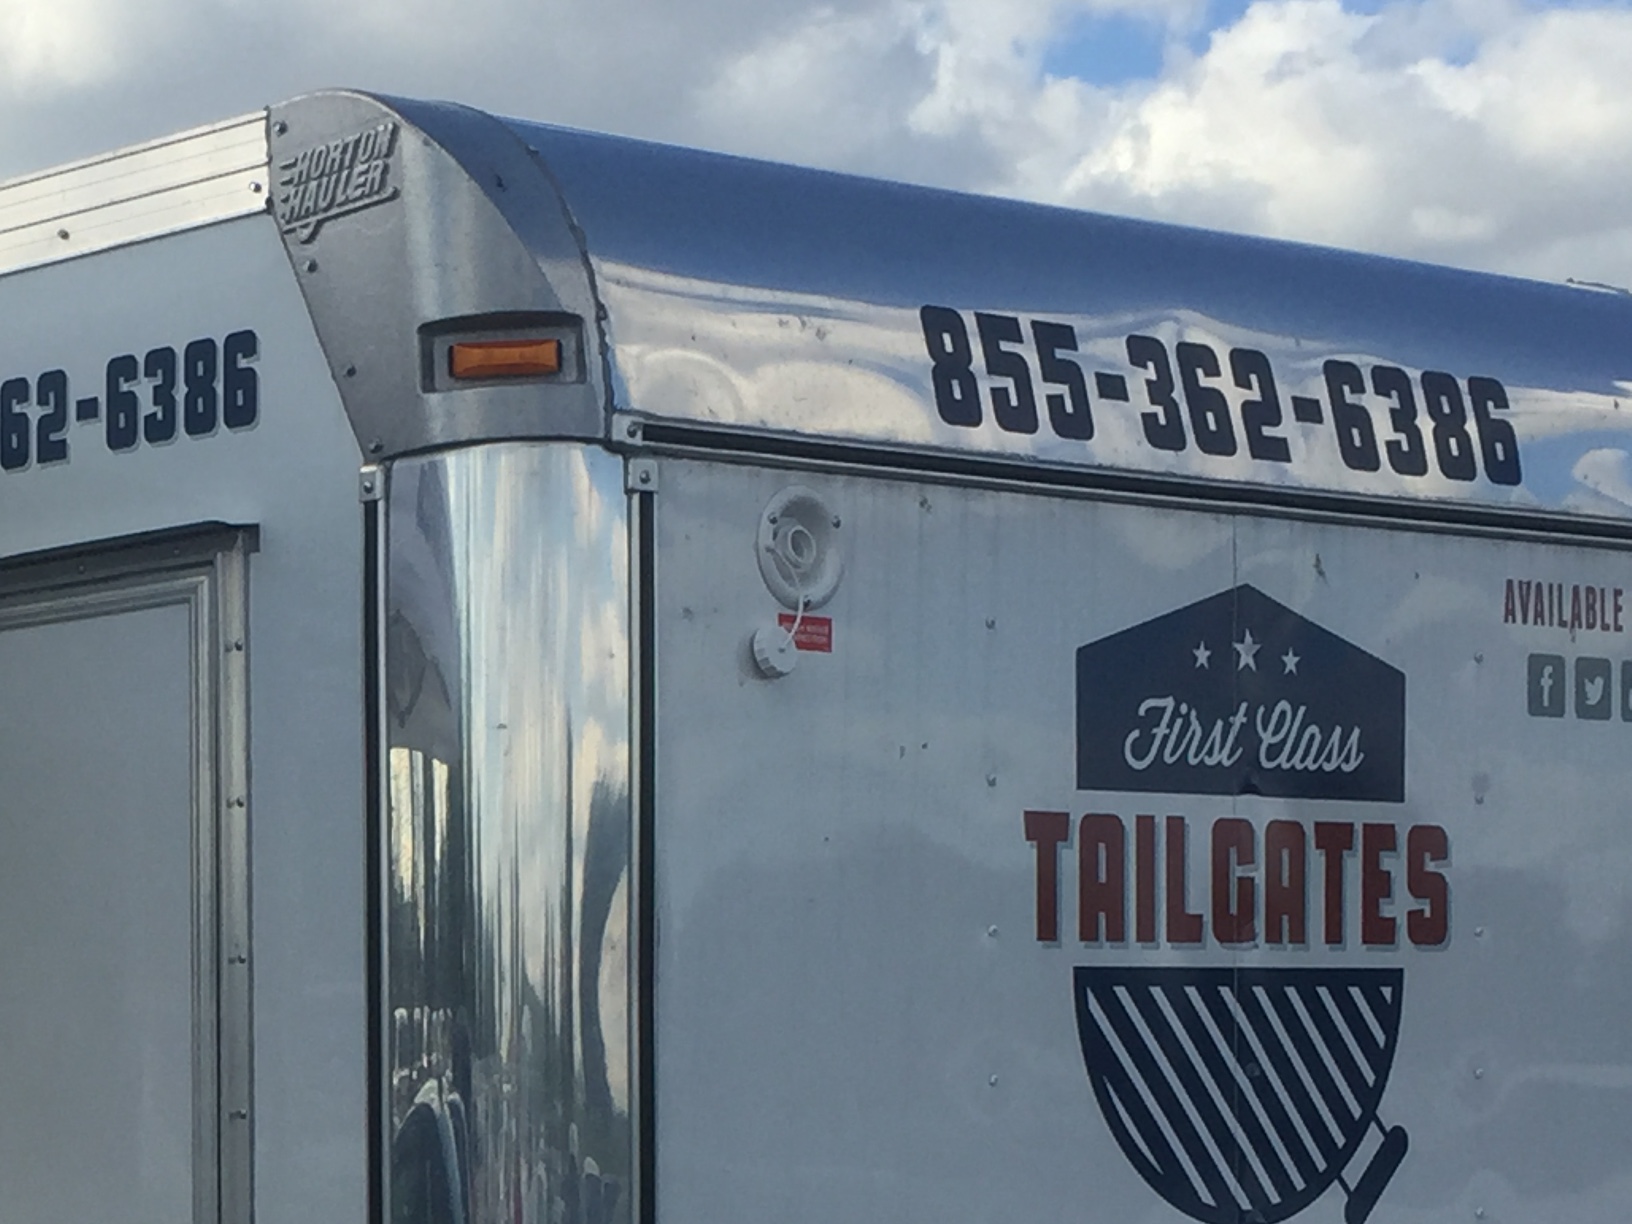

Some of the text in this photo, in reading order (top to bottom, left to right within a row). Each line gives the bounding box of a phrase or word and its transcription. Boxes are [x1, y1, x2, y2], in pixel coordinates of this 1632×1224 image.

[289, 122, 400, 187] HORTON
[284, 160, 390, 225] HAULER
[919, 304, 1522, 486] 855-362-6386
[1503, 578, 1624, 632] AVAILABLE
[1124, 695, 1365, 773] First Class
[1023, 810, 1450, 948] TAILGATES
